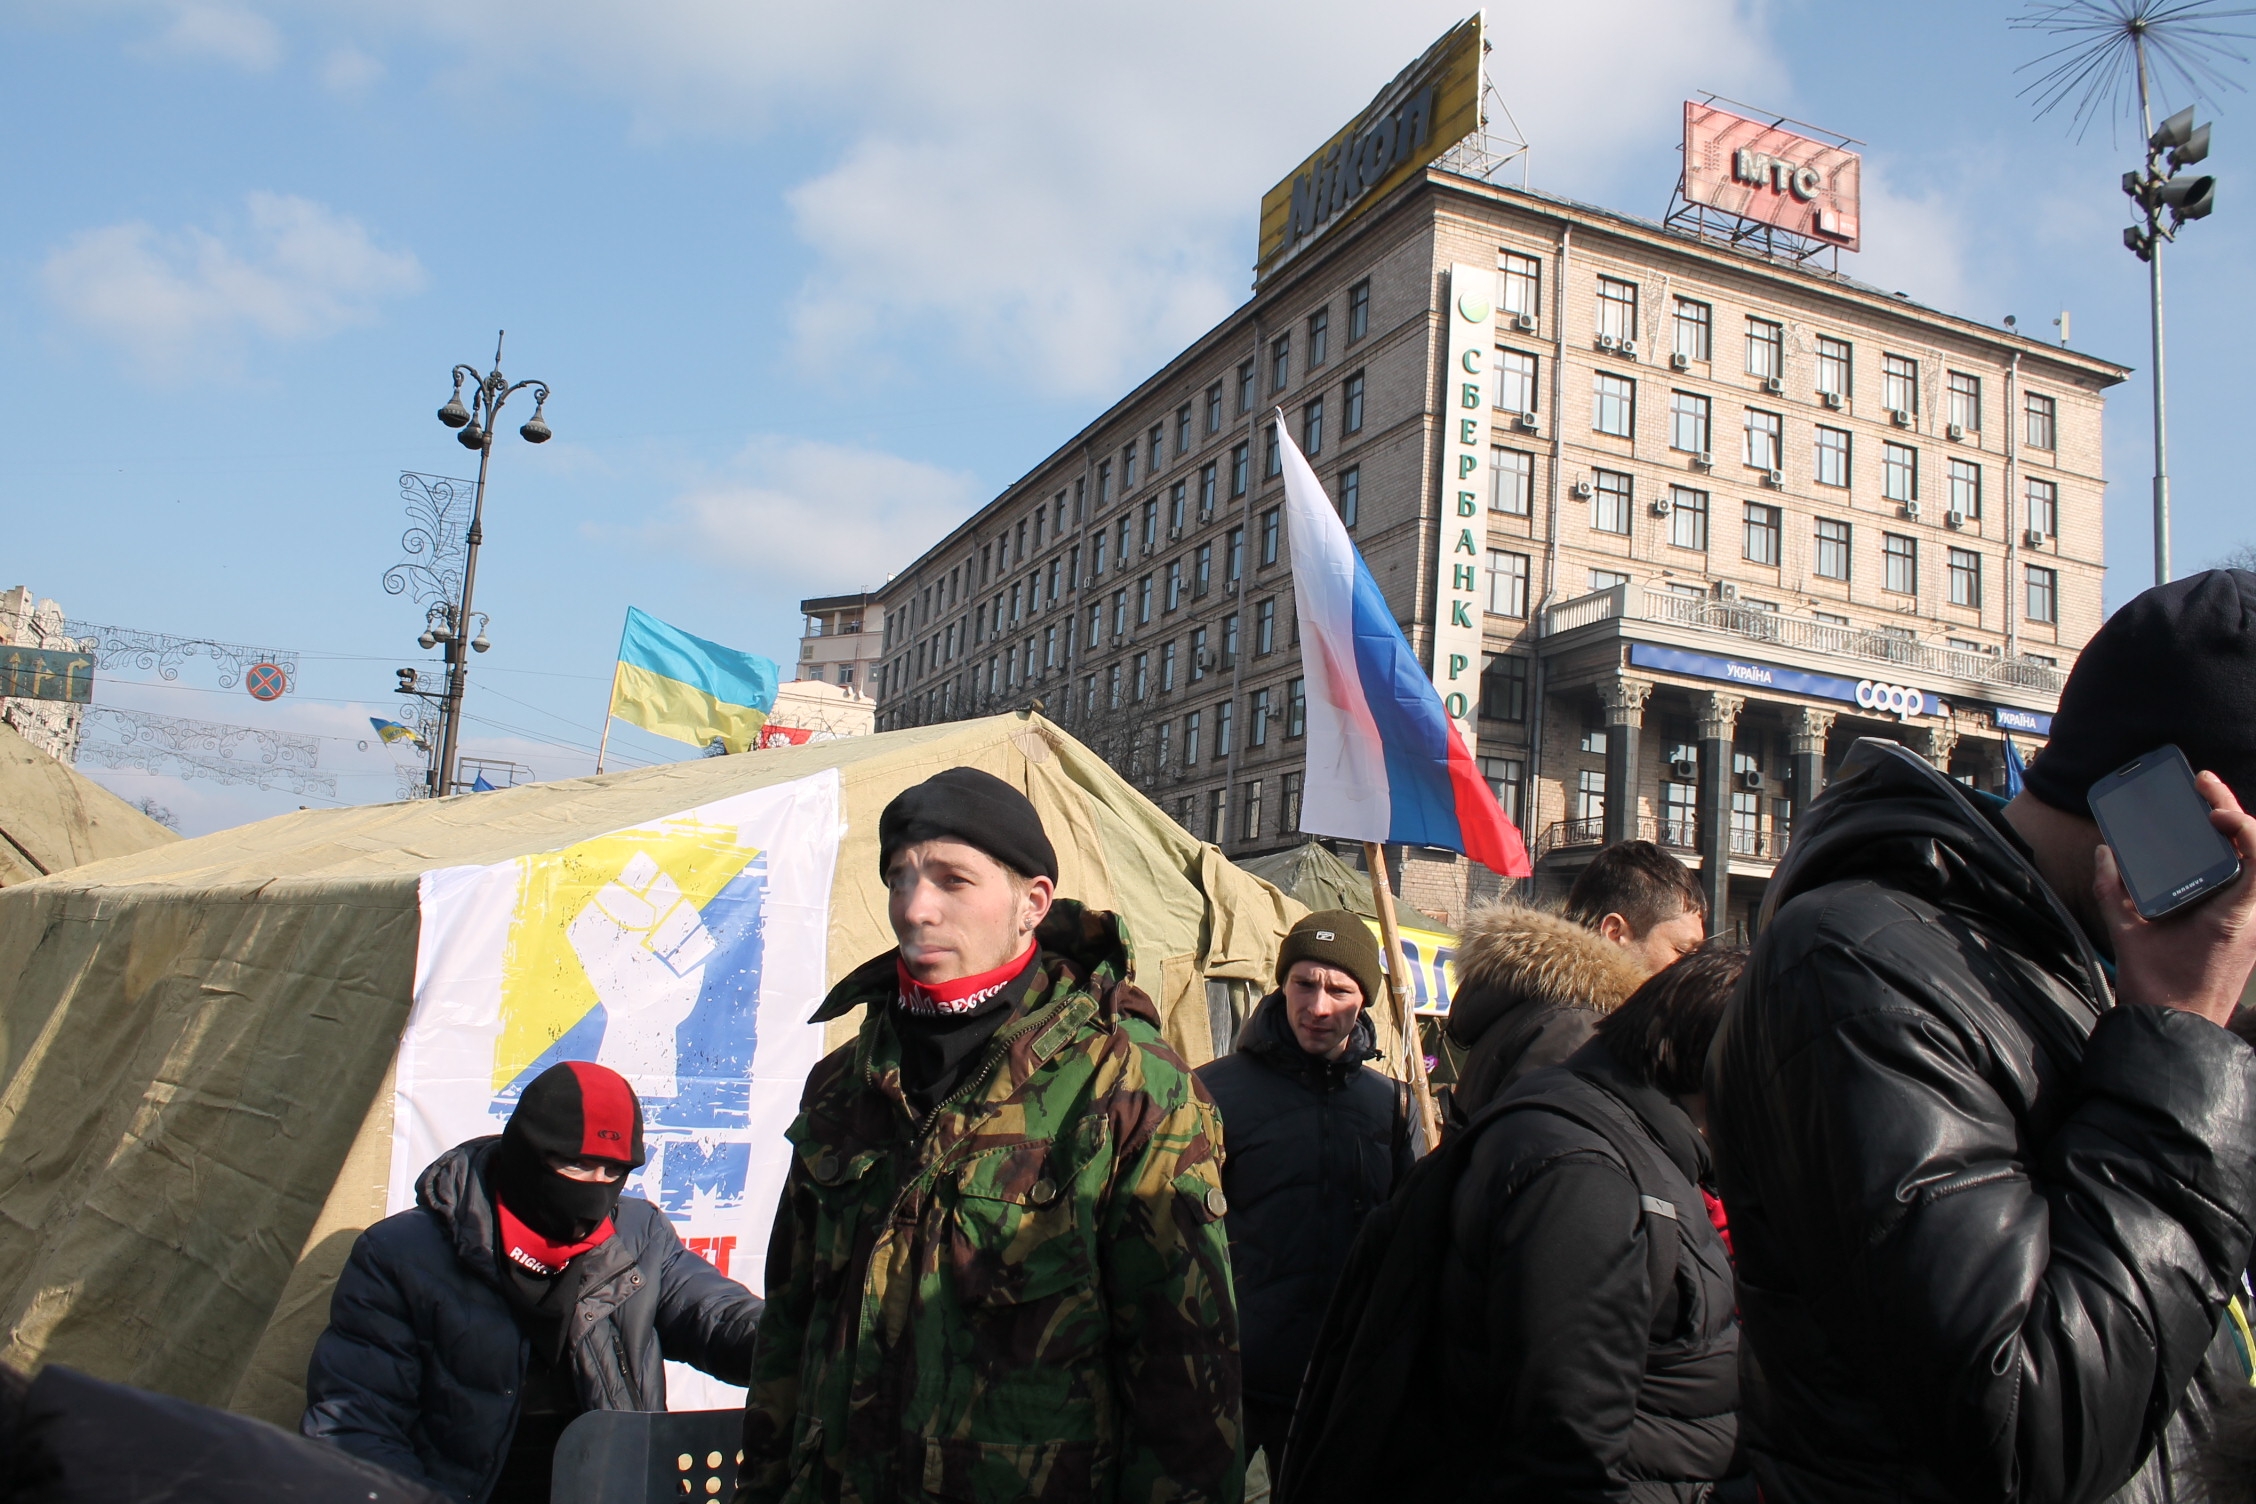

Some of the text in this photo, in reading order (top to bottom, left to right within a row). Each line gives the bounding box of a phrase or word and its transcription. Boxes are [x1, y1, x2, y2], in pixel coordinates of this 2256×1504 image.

[1283, 84, 1433, 249] Nikon
[1737, 147, 1820, 200] МТС
[1445, 348, 1482, 720] СБЕРБАНК РО
[1727, 664, 1772, 684] УКРАЇНА
[1855, 679, 1923, 721] coop
[1998, 711, 2037, 729] УКРАЇНА
[2172, 877, 2204, 897] SAMSUNG
